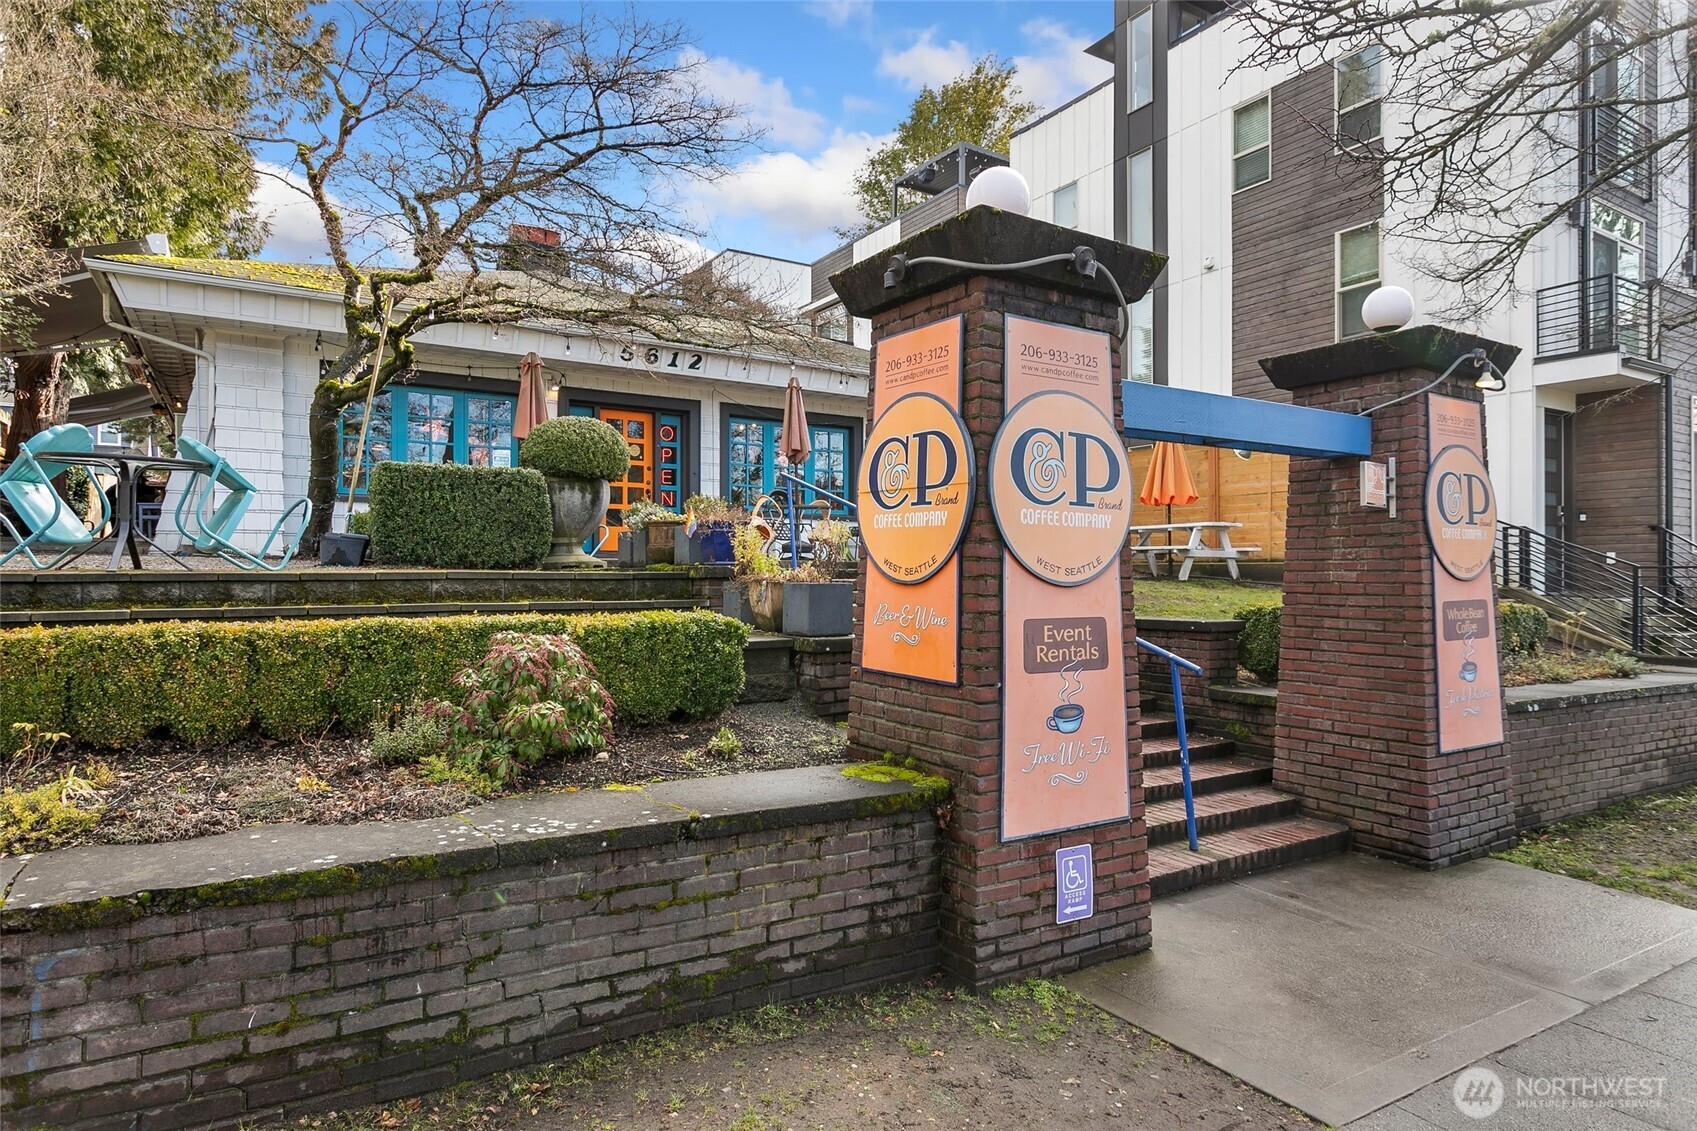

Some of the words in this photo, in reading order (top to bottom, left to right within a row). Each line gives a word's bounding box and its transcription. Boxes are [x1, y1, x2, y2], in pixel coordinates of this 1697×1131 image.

[620, 344, 703, 370] 5612
[885, 345, 949, 372] 206-933-3125
[1020, 343, 1098, 369] 206-933-3125
[1436, 413, 1475, 427] 206-933-3125
[660, 426, 674, 506] OPEN
[868, 430, 958, 511] C&P
[1010, 427, 1121, 508] C&P
[935, 491, 959, 506] Brand
[1098, 497, 1123, 510] Brand
[874, 513, 903, 529] COFFEE
[904, 510, 948, 528] COMPANY
[1020, 508, 1060, 526] COFFEE
[1062, 511, 1112, 529] COMPANY
[1441, 527, 1461, 539] COFFEE
[1462, 528, 1488, 540] COMPANY
[883, 557, 902, 574] WEST
[904, 554, 938, 576] SEATTLE
[1036, 556, 1061, 575] WEST
[1064, 555, 1103, 577] SEATTLE
[1450, 561, 1463, 573] WEST
[1464, 560, 1483, 574] SEATTLE
[873, 603, 899, 625] Beer
[915, 605, 948, 630] Wine
[1456, 620, 1478, 634] Coffee
[1044, 625, 1092, 642] Event
[1036, 642, 1099, 663] Rentals
[1021, 743, 1059, 773] Free
[1059, 736, 1111, 765] Wi-Fi
[1065, 890, 1086, 900] ACCESS
[1068, 897, 1083, 905] RAMP
